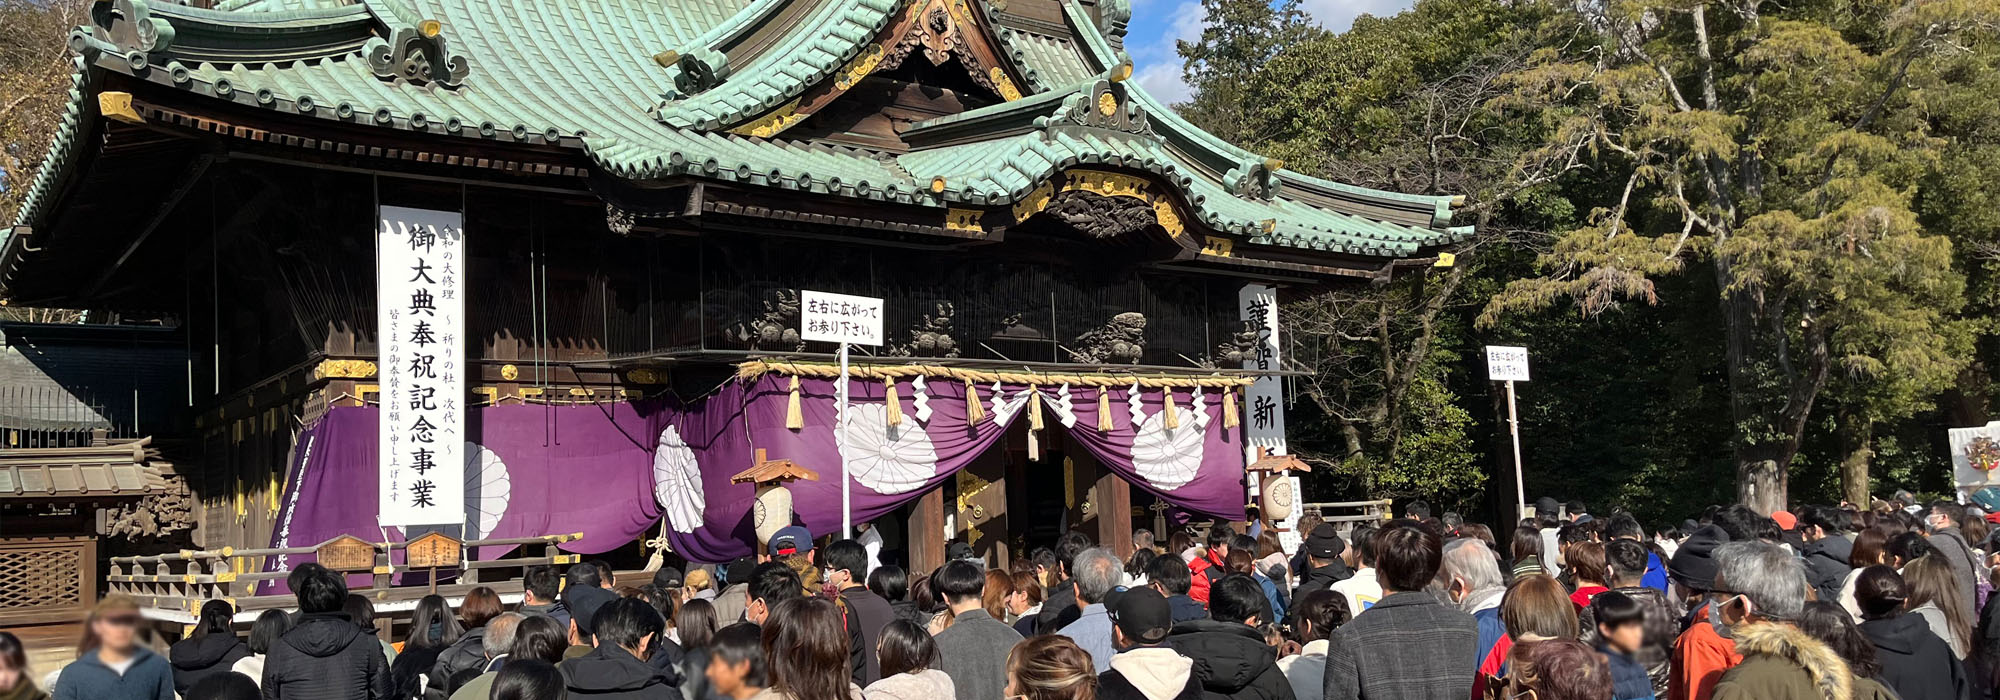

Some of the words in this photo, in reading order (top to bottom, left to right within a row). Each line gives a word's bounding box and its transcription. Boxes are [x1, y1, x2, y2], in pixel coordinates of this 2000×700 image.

[441, 223, 455, 300] 令和の大修理
[808, 297, 877, 319] 左右に広がって
[407, 224, 437, 509] 御大典奉祝記念事業
[808, 318, 875, 339] お参り下さい。
[1246, 299, 1277, 475] 謹賀新
[388, 308, 401, 503] 皆さまの御奉賛をお願い申し上げます
